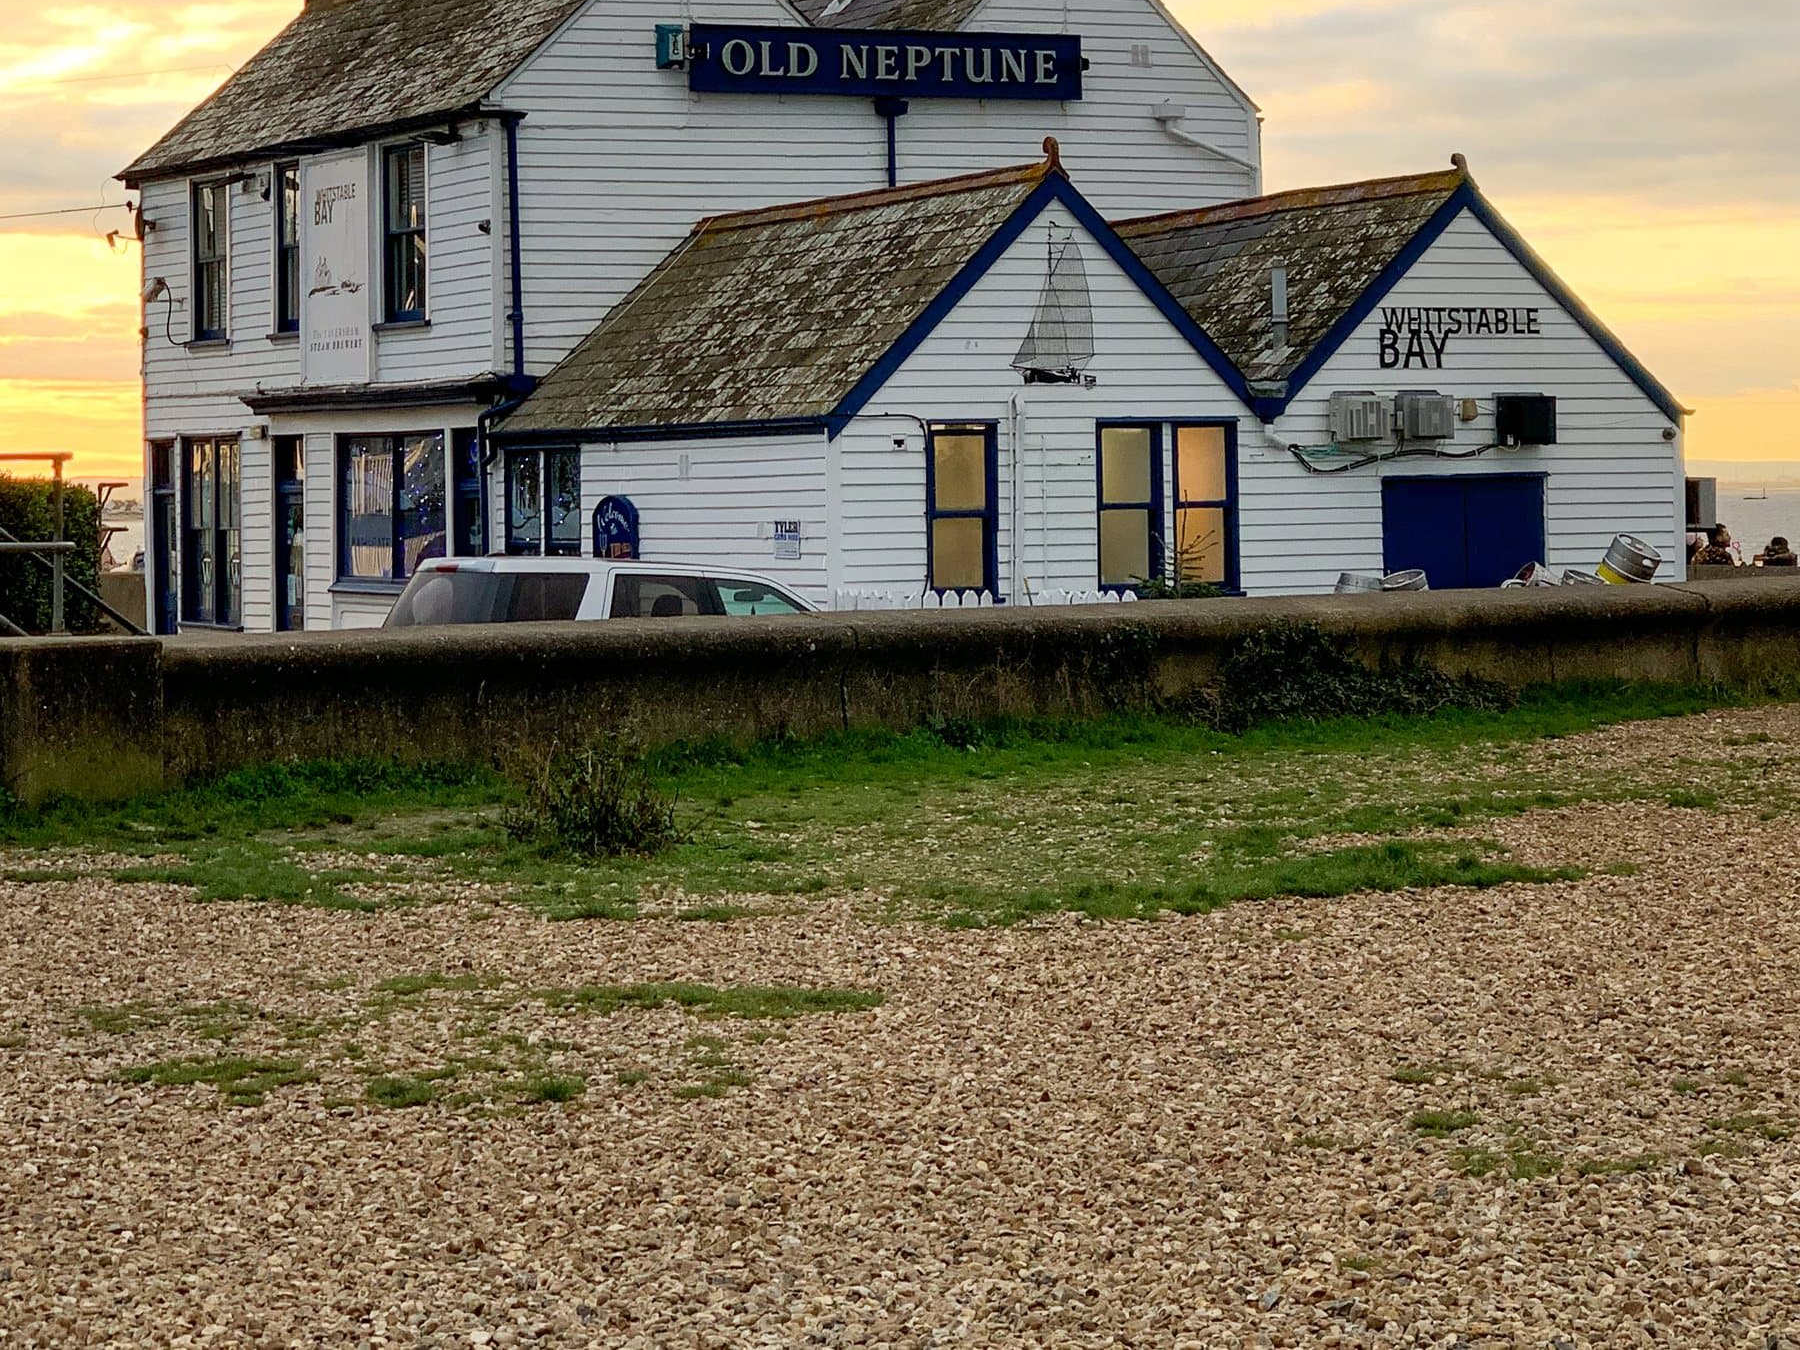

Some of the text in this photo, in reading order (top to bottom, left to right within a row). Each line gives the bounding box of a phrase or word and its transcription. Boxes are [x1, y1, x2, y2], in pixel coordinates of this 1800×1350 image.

[721, 38, 1059, 84] OLD NEPTUNE
[316, 183, 355, 202] WHITSTABLE
[314, 201, 333, 226] BAY
[1382, 307, 1541, 335] WHITSTABLE
[1379, 328, 1449, 369] BAY
